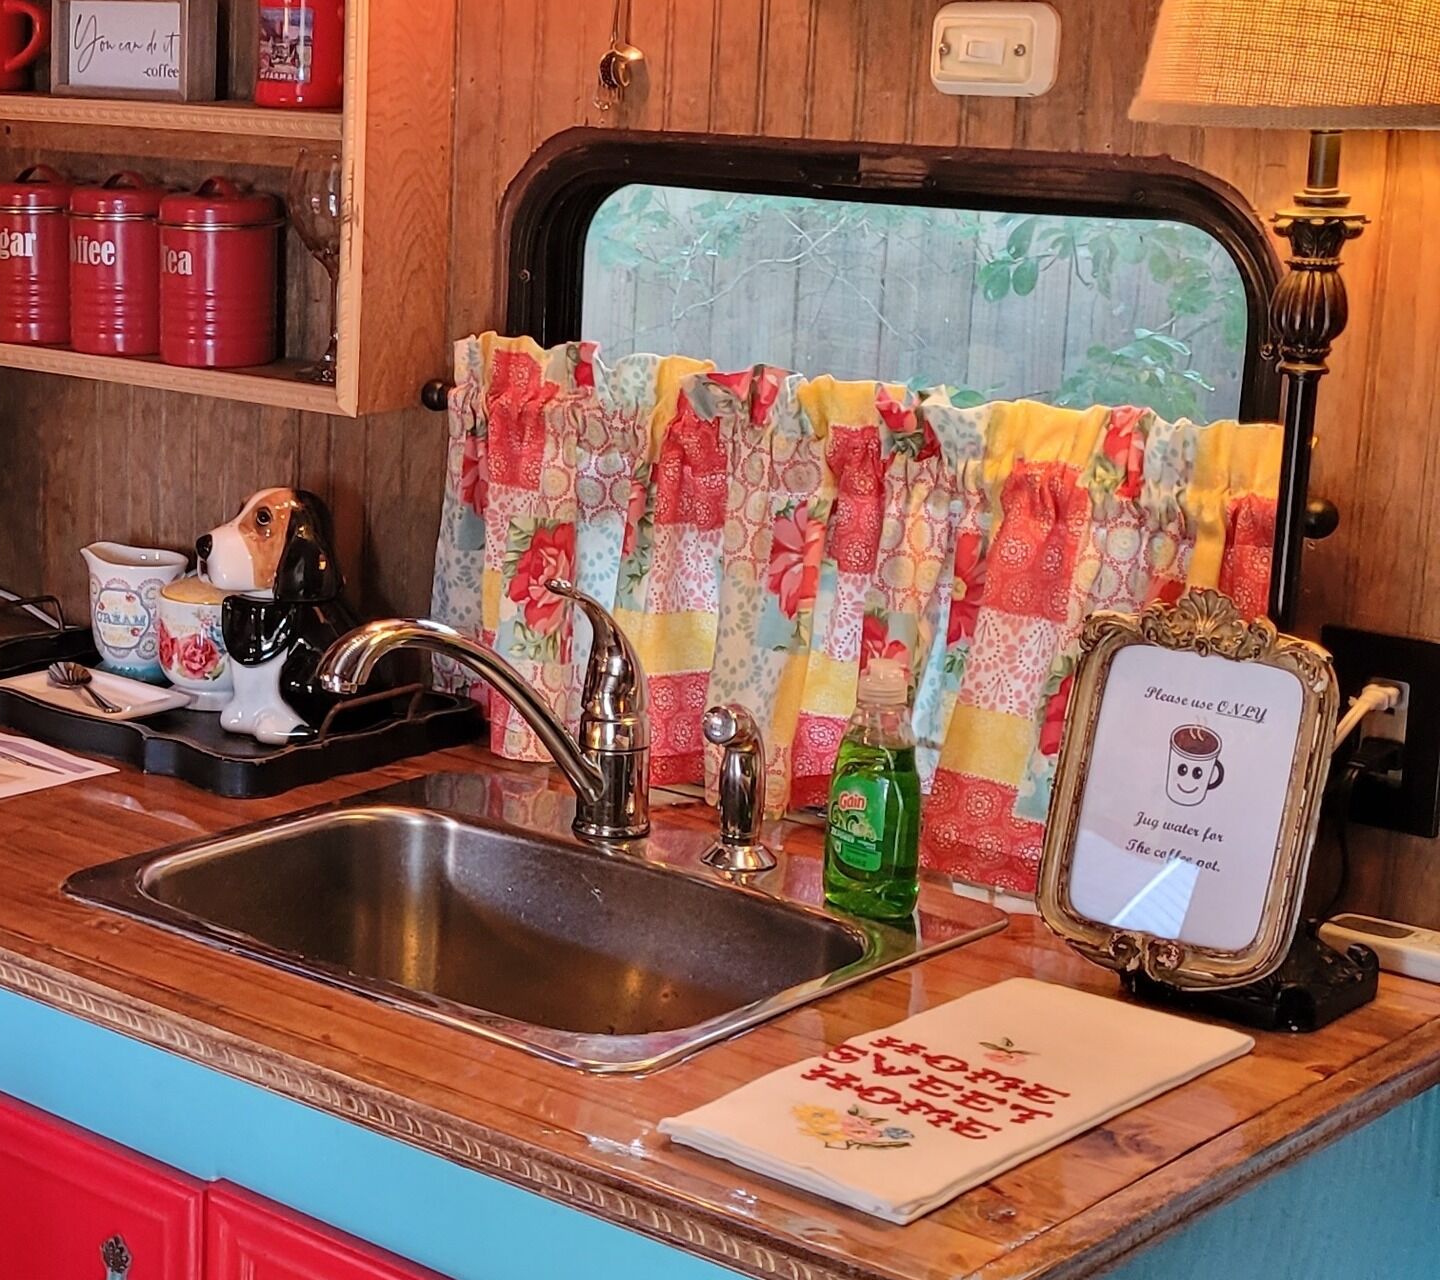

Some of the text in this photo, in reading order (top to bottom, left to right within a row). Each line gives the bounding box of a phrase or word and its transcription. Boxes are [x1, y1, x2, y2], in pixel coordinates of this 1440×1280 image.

[74, 13, 182, 74] You can do it
[1144, 686, 1268, 724] Please use ONLY
[839, 791, 867, 811] Gain
[1133, 811, 1224, 842] Jug water for
[1125, 839, 1152, 855] The
